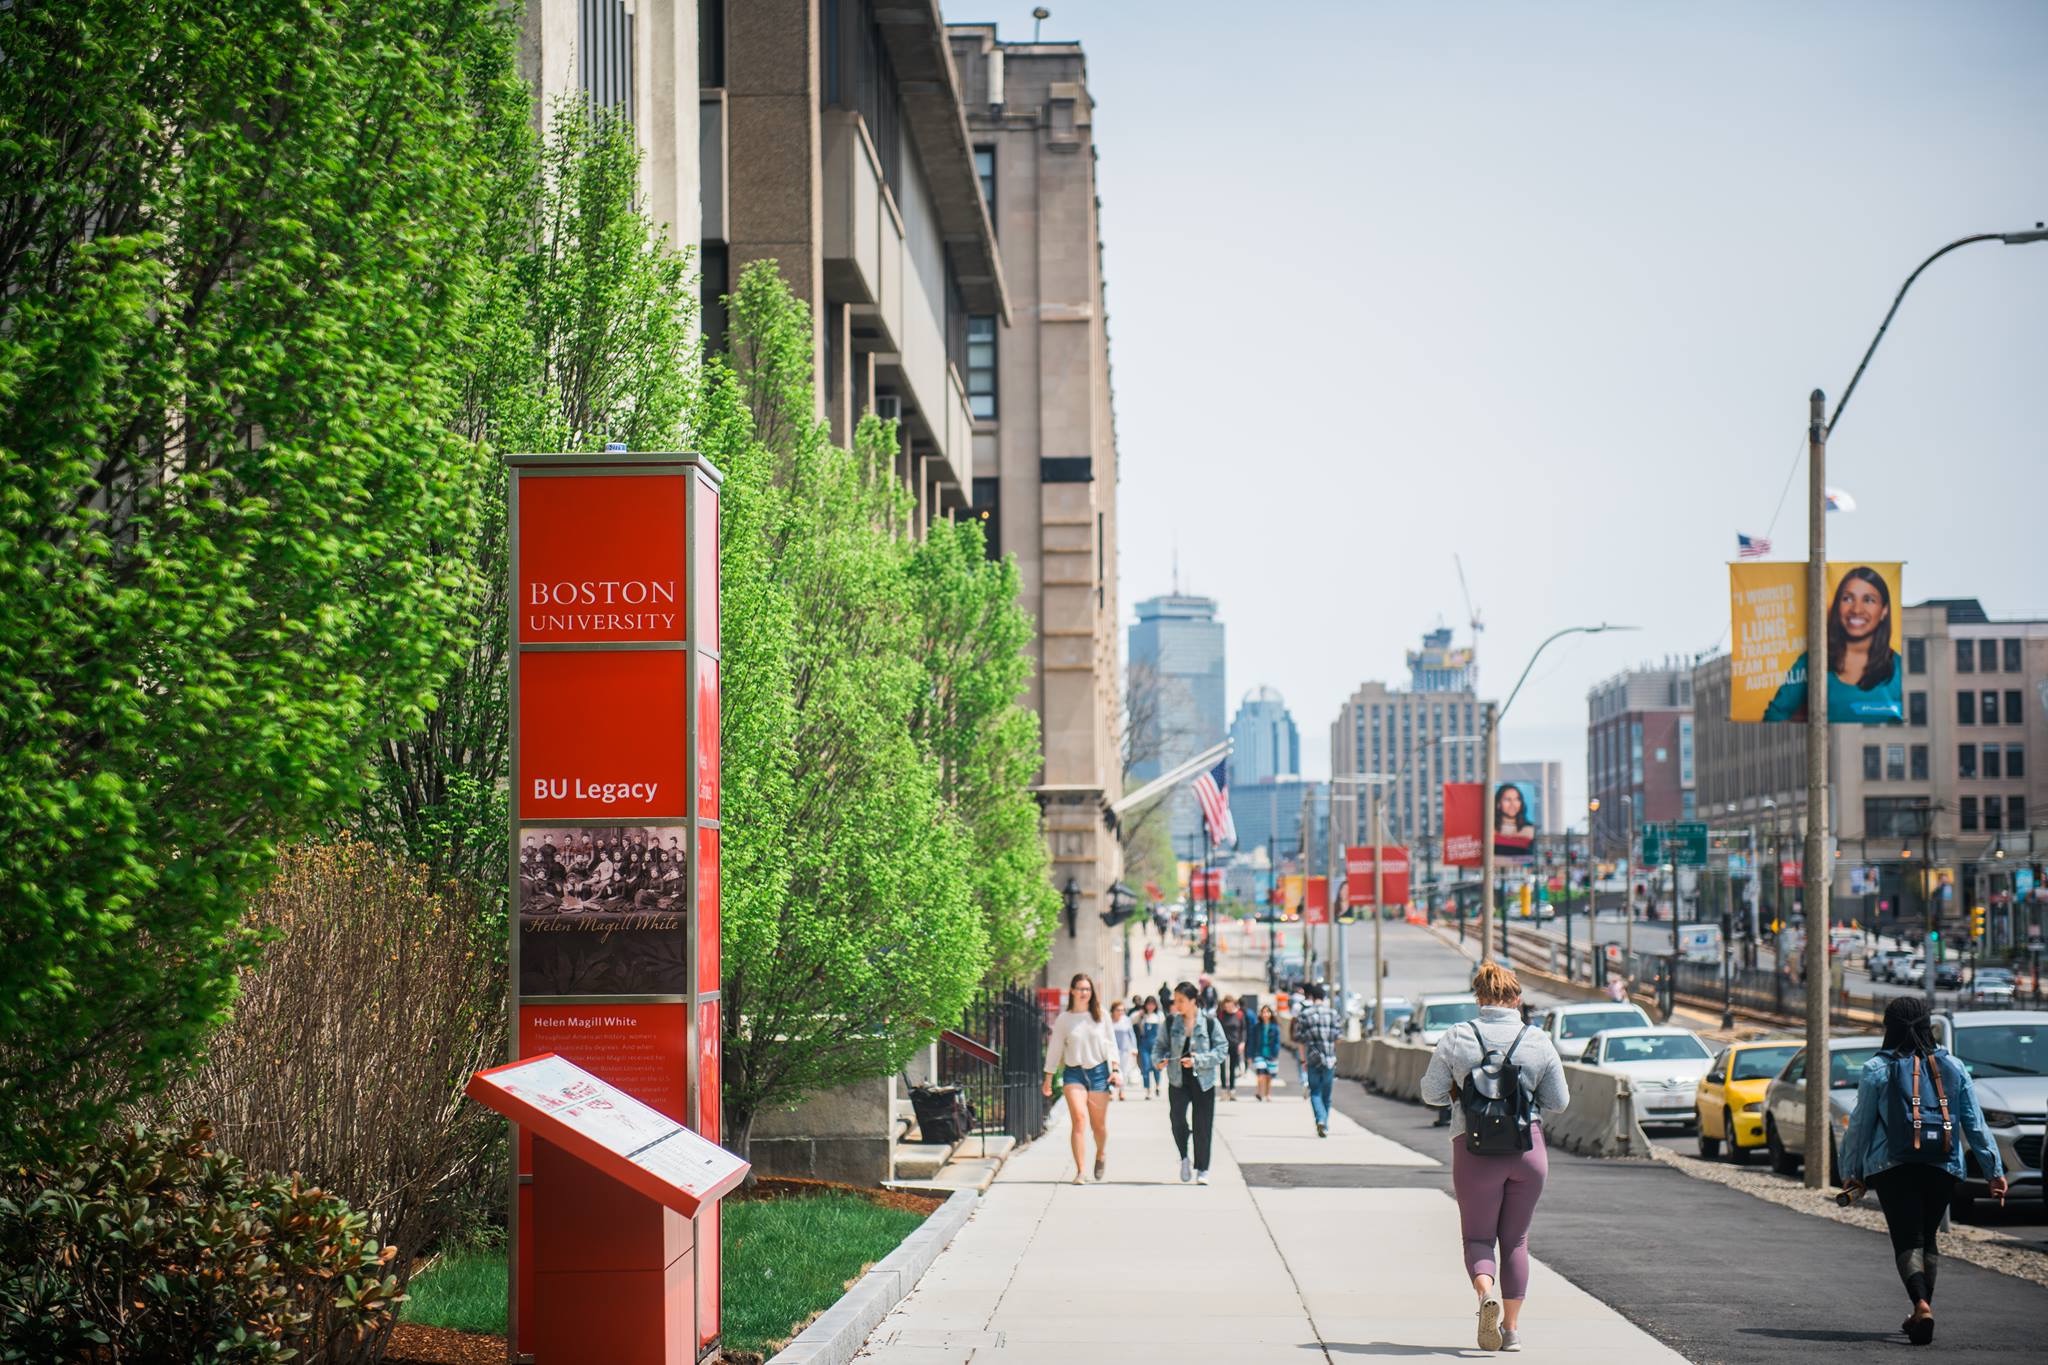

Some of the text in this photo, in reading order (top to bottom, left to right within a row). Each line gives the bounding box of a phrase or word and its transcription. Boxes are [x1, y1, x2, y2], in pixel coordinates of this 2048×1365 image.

[530, 581, 675, 605] BOSTON
[1755, 599, 1797, 618] WITH A
[530, 614, 675, 631] UNIVERSITY
[1742, 618, 1795, 642] LUNG-
[1731, 655, 1779, 677] TEAM IN
[1746, 668, 1807, 691] AUSTRALIA
[534, 777, 658, 804] BU Legacy
[526, 911, 679, 944] Helen Magill White
[534, 1016, 637, 1029] Helen Magill White
